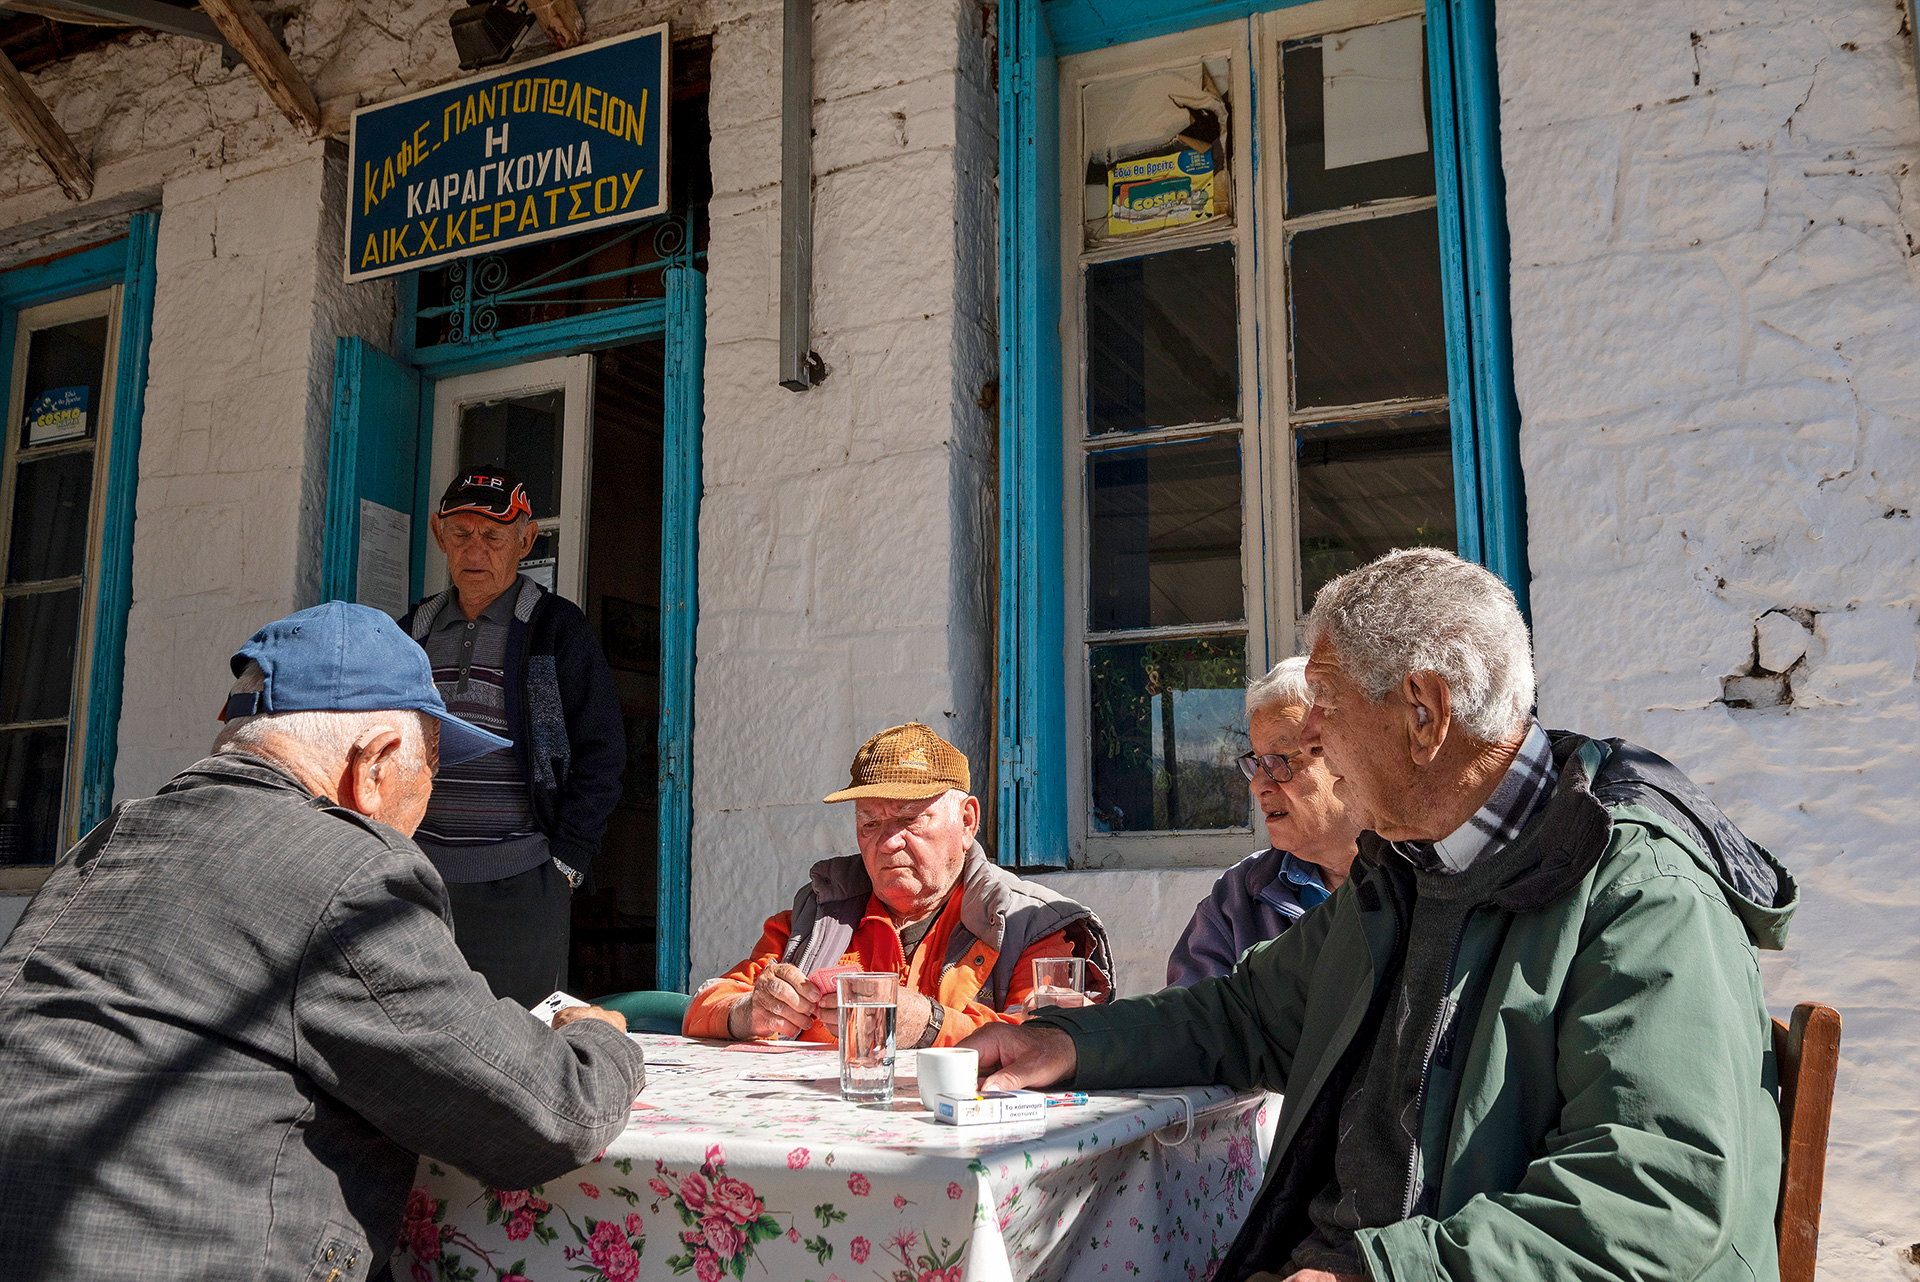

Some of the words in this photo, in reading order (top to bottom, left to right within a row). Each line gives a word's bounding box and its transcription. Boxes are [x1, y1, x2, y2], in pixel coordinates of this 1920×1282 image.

[485, 123, 509, 158] Η
[407, 140, 592, 218] ΚΑΡΑΓΚΟΥΝΑ
[1133, 165, 1144, 176] θα
[1146, 160, 1174, 176] βρείτε
[1132, 190, 1188, 212] COSMO
[37, 408, 80, 427] COSMO
